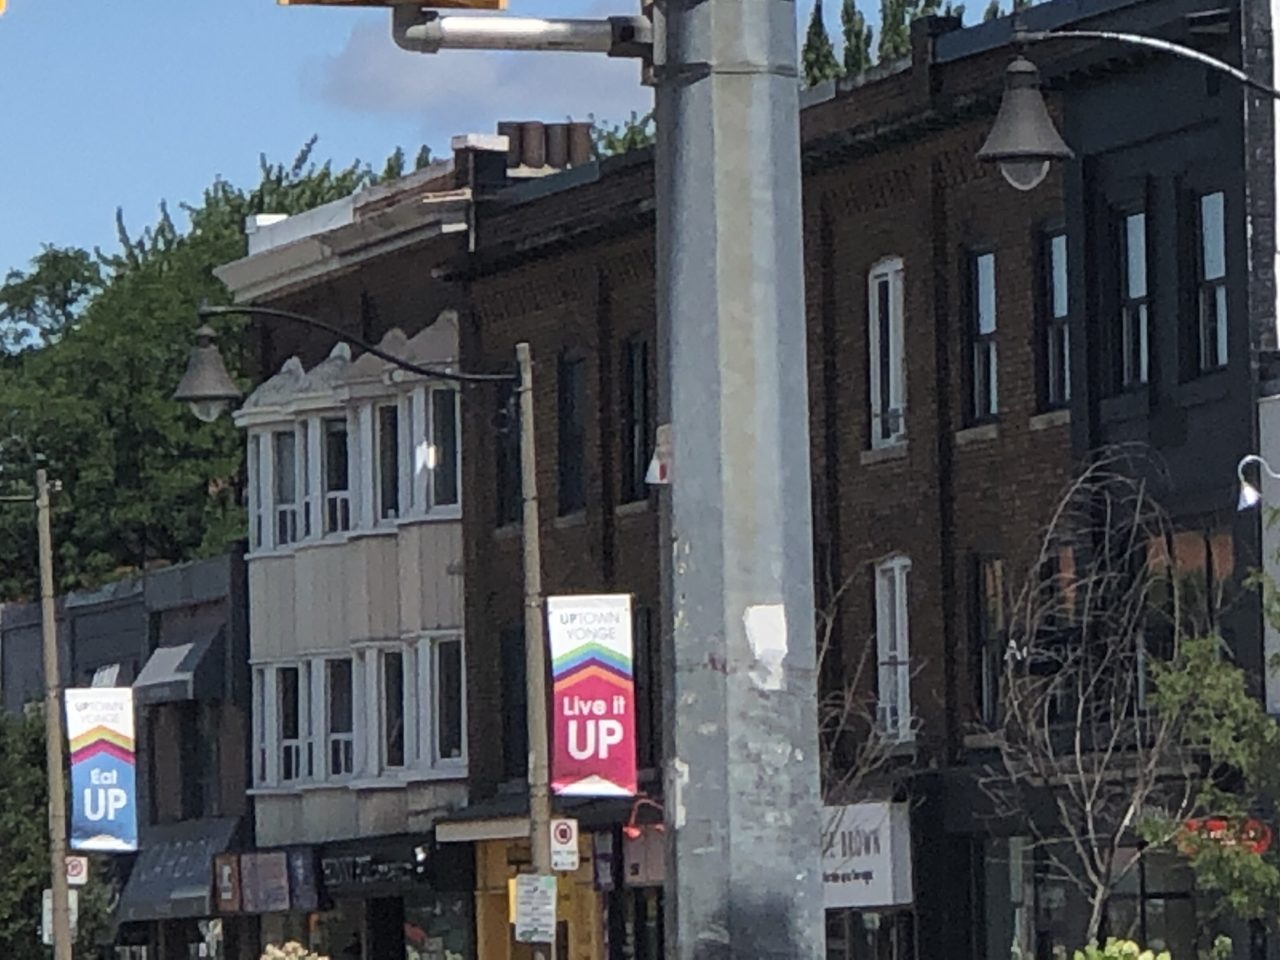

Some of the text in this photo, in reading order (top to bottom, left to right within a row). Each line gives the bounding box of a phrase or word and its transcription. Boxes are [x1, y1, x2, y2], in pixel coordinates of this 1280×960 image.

[559, 611, 621, 625] UPTOWN
[566, 627, 616, 640] YONGE
[563, 695, 626, 716] Live it
[567, 719, 624, 761] UP
[90, 768, 118, 785] Eat
[84, 787, 127, 821] UP
